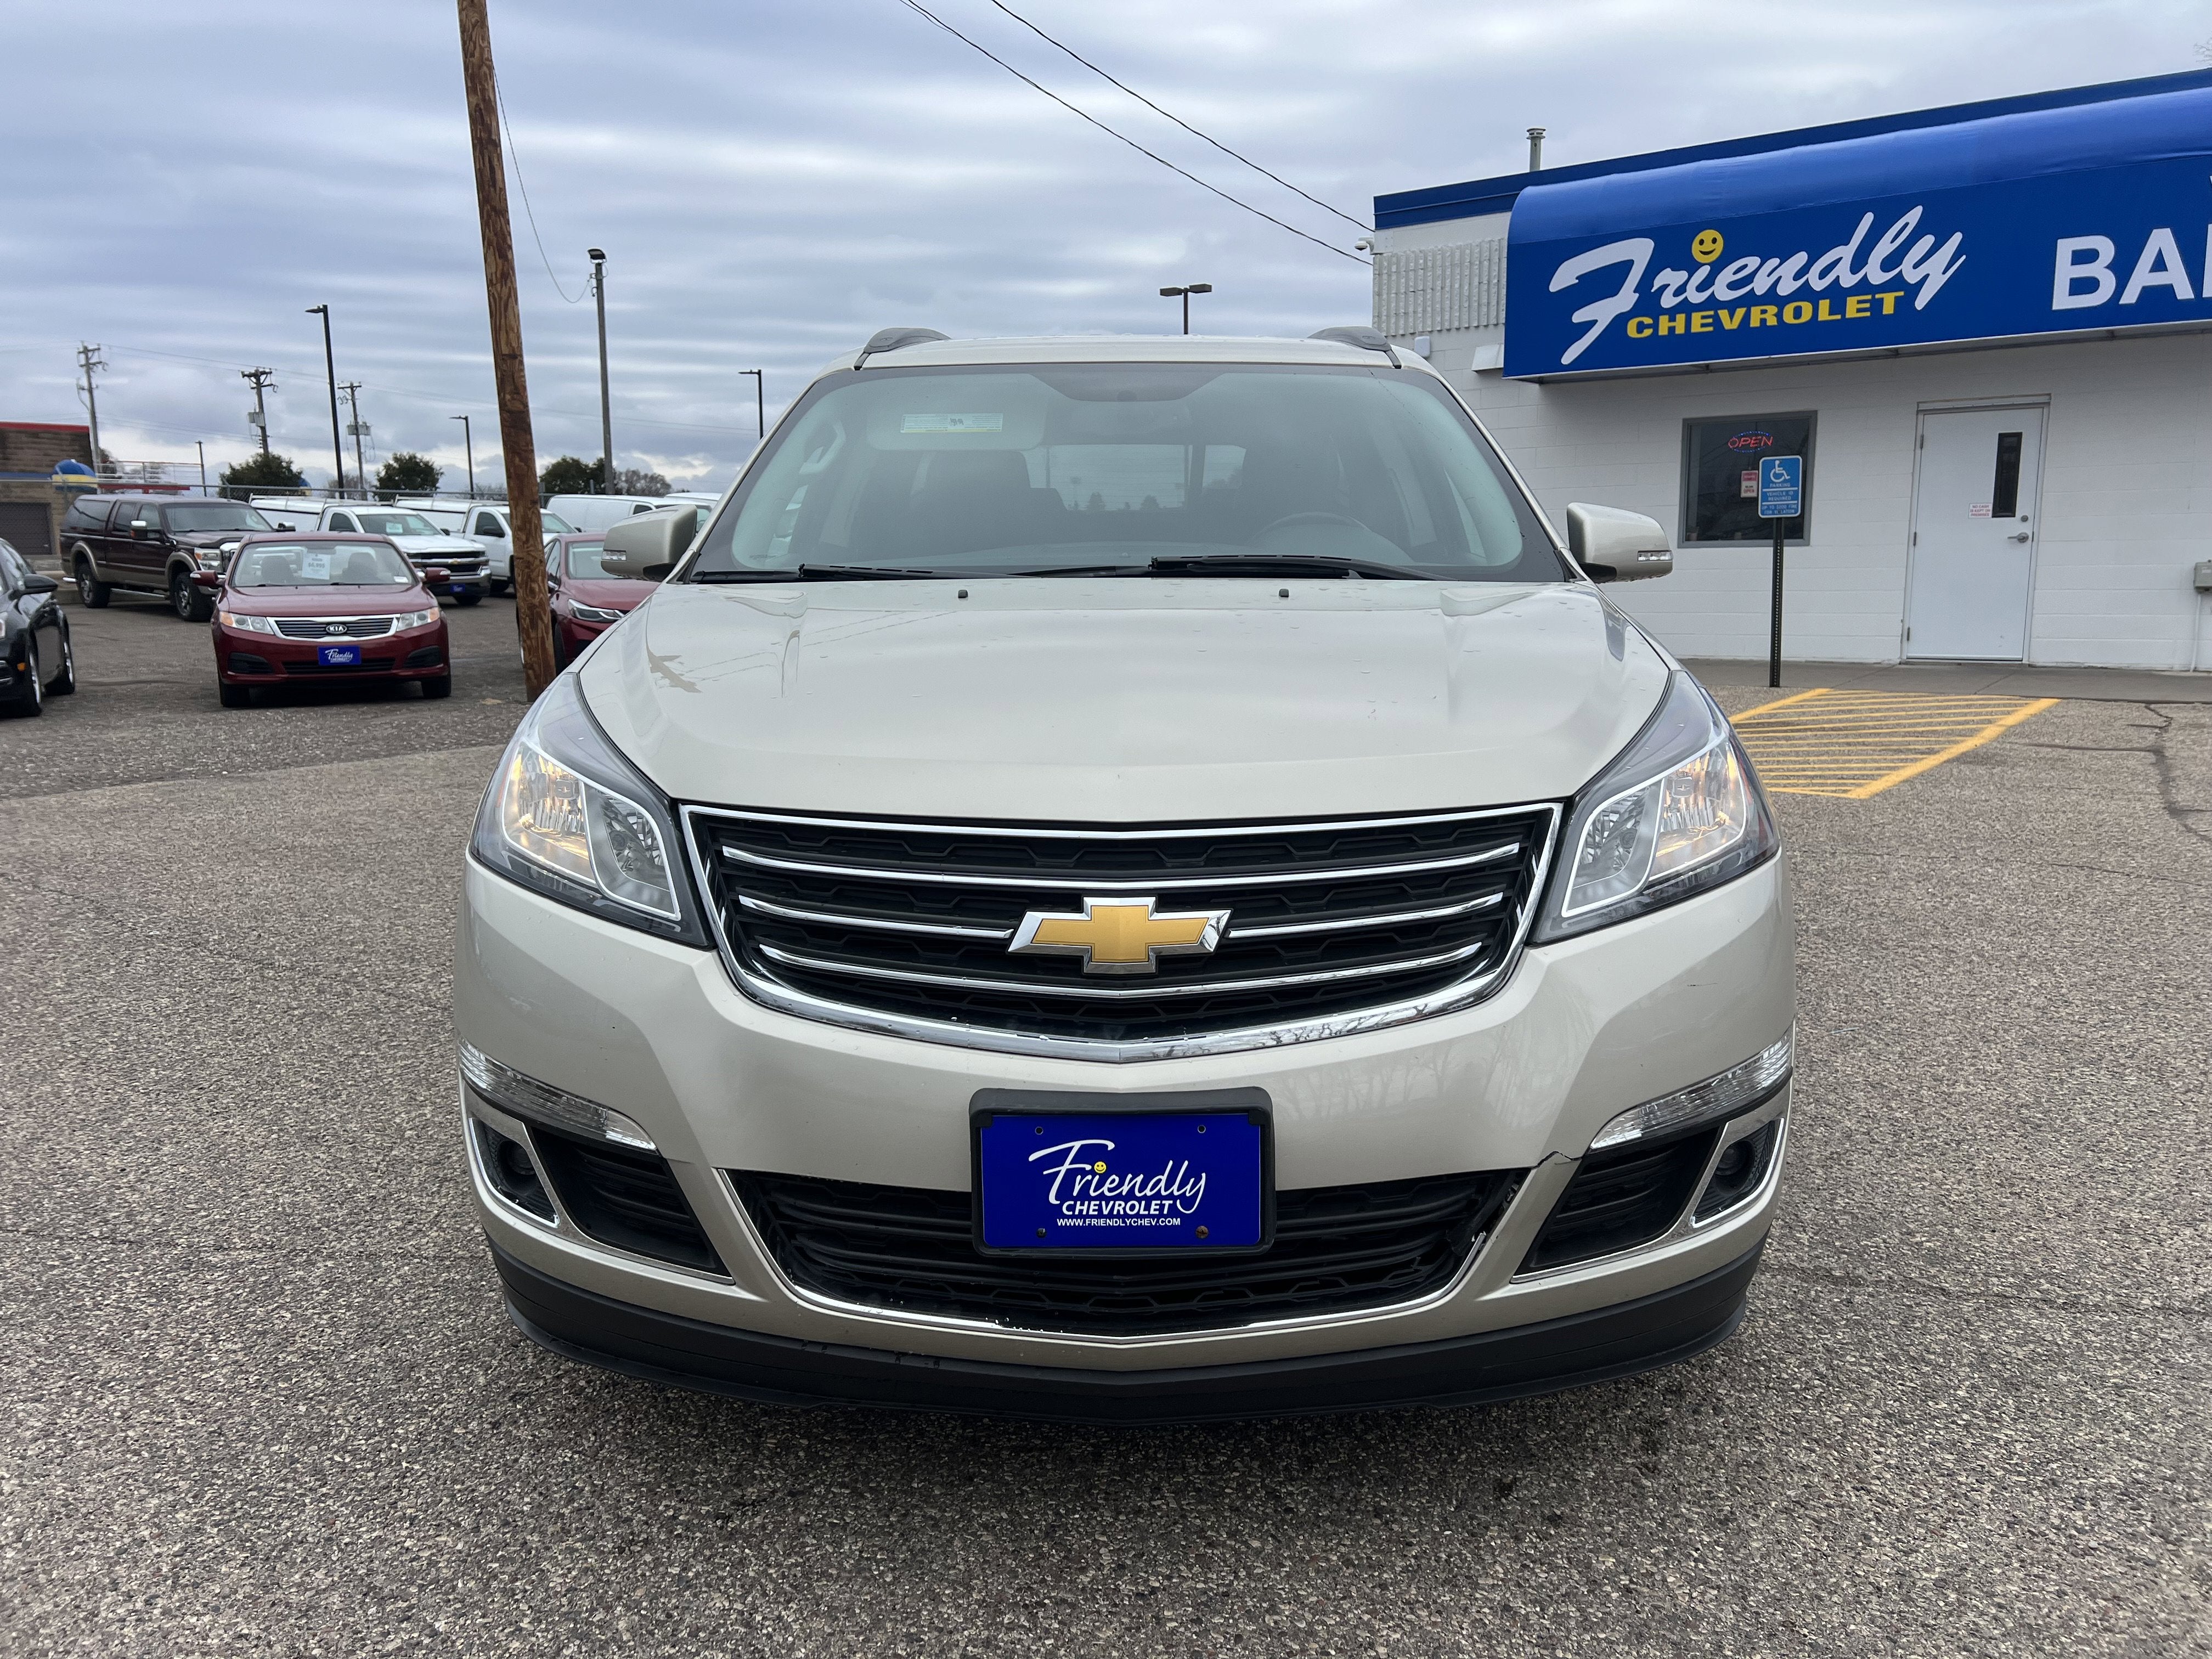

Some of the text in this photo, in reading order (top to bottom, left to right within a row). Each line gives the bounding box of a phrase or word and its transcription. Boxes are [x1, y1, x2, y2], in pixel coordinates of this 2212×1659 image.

[2052, 223, 2212, 311] BA
[1549, 205, 1966, 365] Friendly
[1627, 291, 1904, 338] CHEVROLET
[1728, 436, 1773, 448] OPEN
[325, 648, 353, 661] Friendly
[1028, 1139, 1206, 1214] Friendly
[1057, 1217, 1181, 1227] WWW.FRIENDLYCHEV.COM
[1062, 1200, 1173, 1215] CHEVROLET
